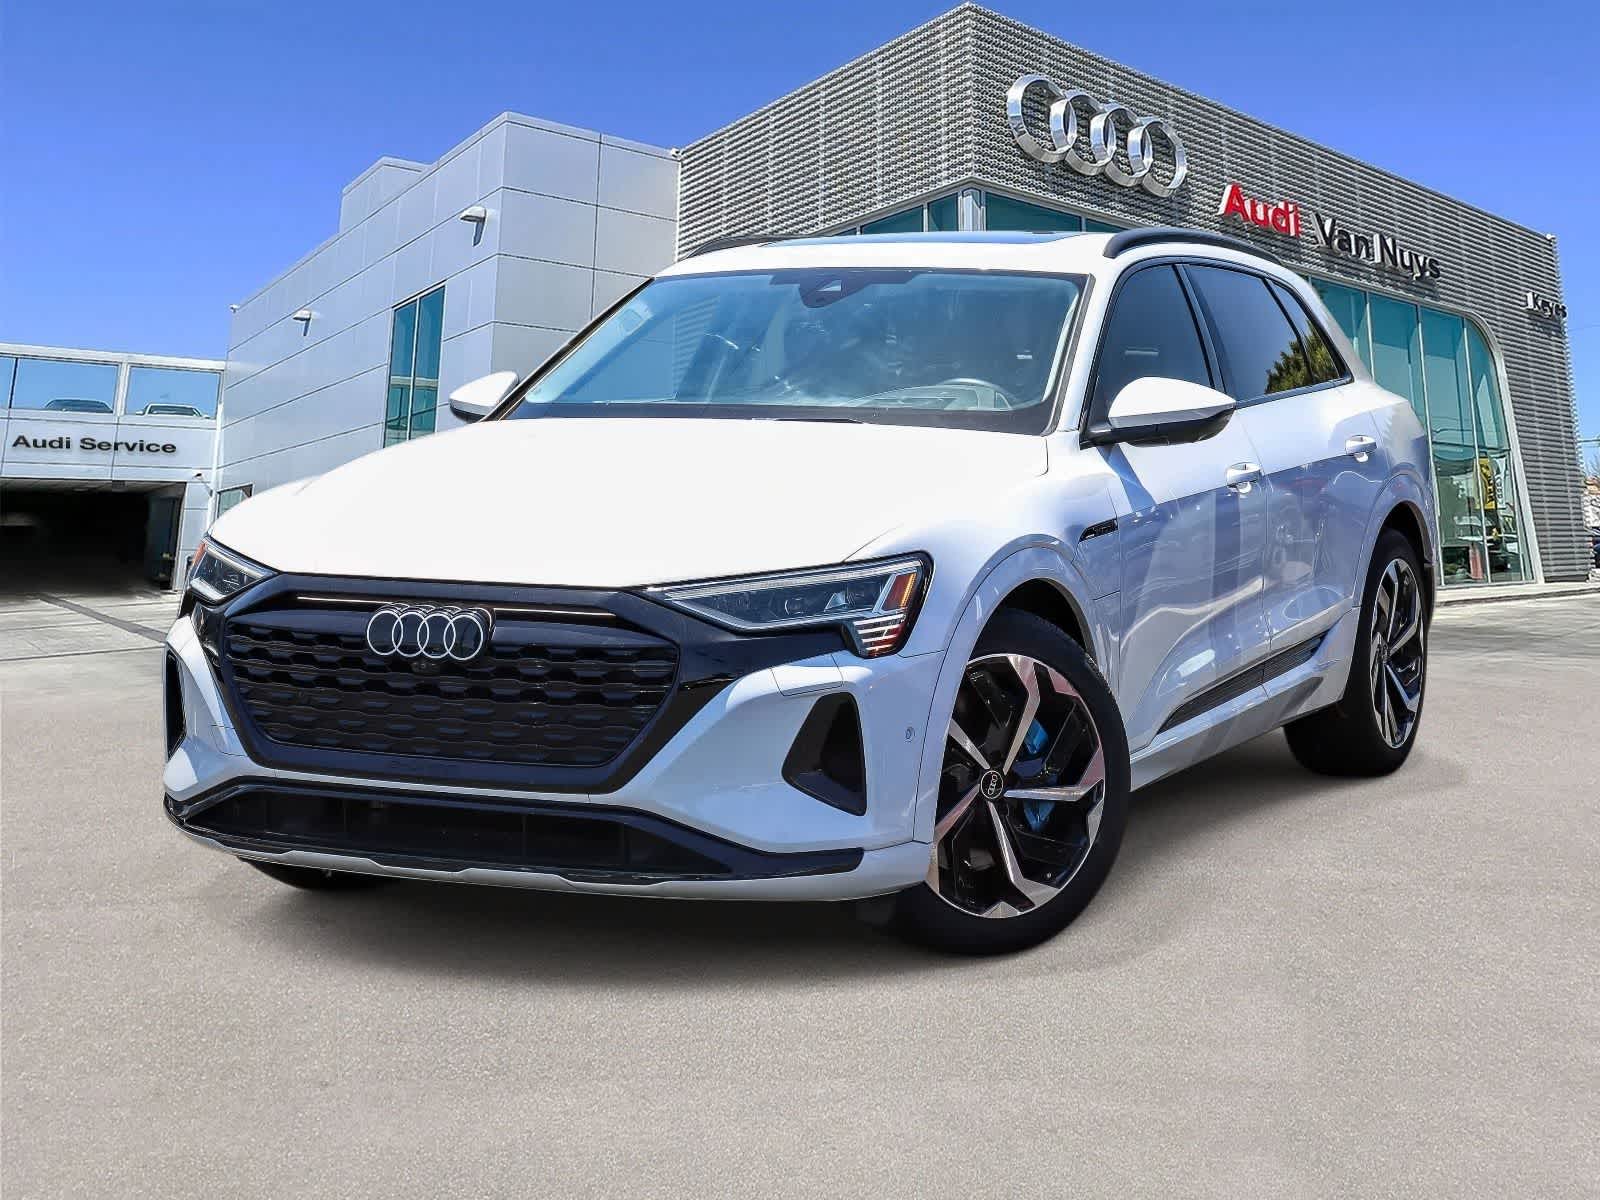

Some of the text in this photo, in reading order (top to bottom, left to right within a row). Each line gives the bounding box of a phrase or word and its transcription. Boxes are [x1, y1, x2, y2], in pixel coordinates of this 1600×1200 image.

[1217, 181, 1441, 281] Audi Van Nuys
[12, 435, 177, 454] Audi Service
